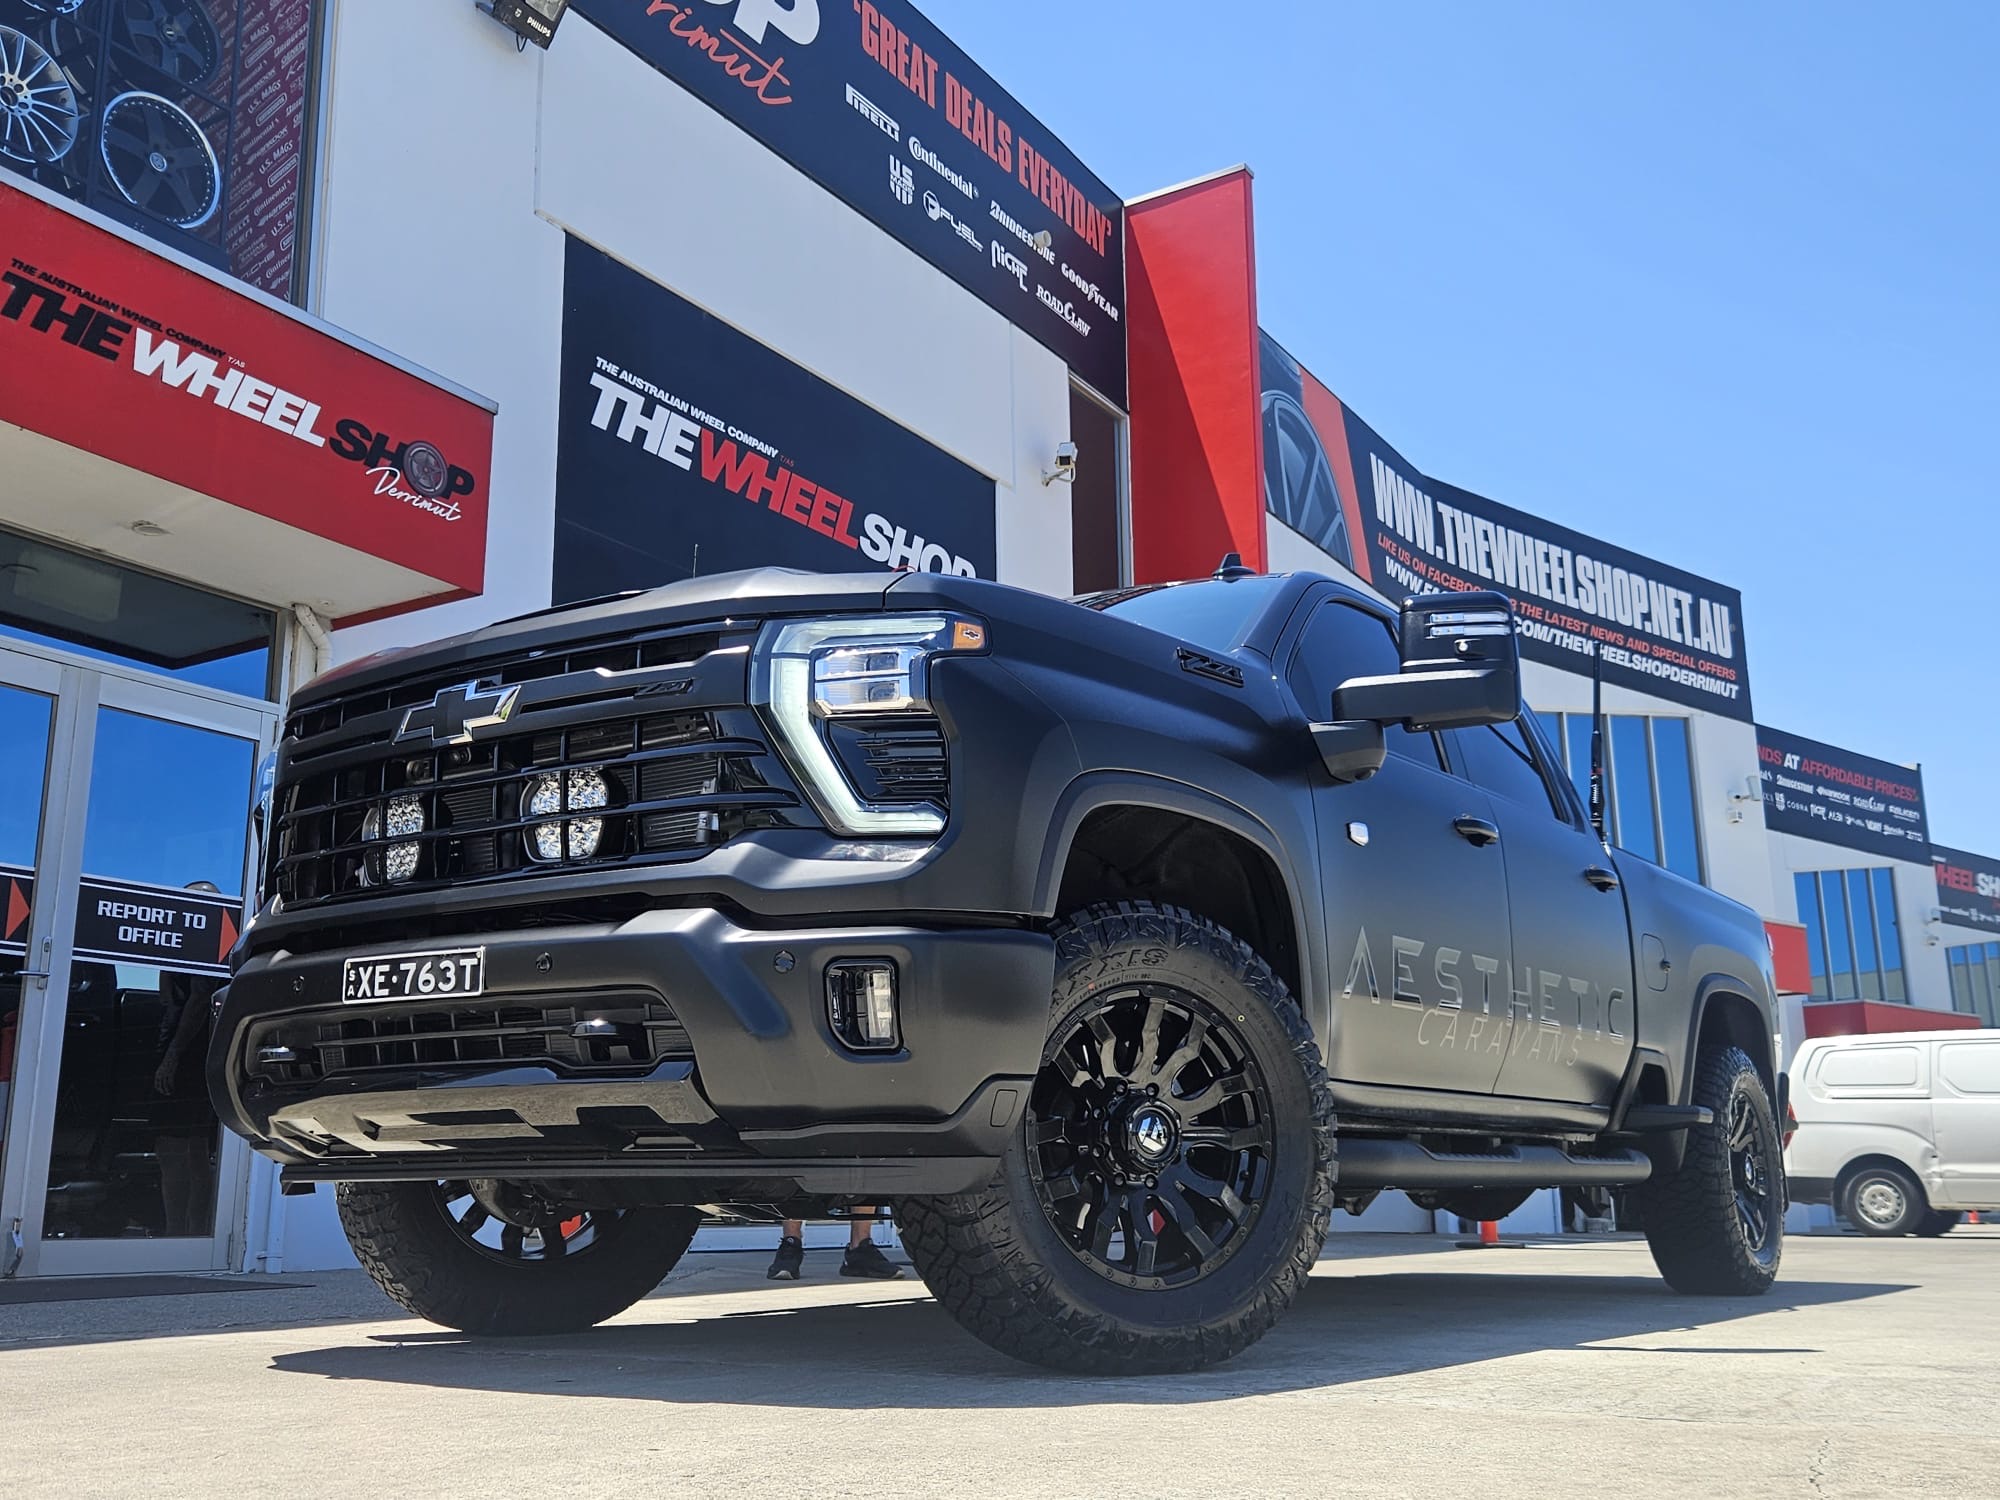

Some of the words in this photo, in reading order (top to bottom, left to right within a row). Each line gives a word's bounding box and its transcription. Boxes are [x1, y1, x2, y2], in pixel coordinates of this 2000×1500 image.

[527, 16, 551, 37] PHILIPS
[262, 79, 281, 100] MAGS
[845, 82, 900, 142] PIRELLI
[945, 71, 1012, 174] DEALS
[259, 158, 274, 175] U.S.
[272, 140, 294, 161] MAGS
[908, 135, 974, 200] Continental
[254, 182, 288, 217] Continental
[271, 219, 286, 237] U.S.
[940, 207, 984, 250] FUEL
[989, 199, 1056, 265] BRIDGESONE
[11, 257, 38, 276] THE
[39, 270, 120, 312] AUSTRALIAN
[118, 306, 163, 333] WHEEL
[165, 327, 227, 360] COMPANY
[227, 355, 246, 369] T/AS
[1, 271, 132, 361] THE
[133, 327, 325, 447] WHEEL
[329, 419, 475, 500] SHOP
[595, 356, 620, 378] THE
[619, 370, 690, 413] AUSTRALIAN
[690, 404, 726, 434] WHEEL
[727, 426, 779, 458] COMPANY
[589, 372, 701, 472] THE
[699, 427, 859, 550] WHEEL
[366, 466, 462, 522] Derrimut
[1369, 452, 1733, 660] WWW.THEWHEELSHOP.NET.AU
[1378, 533, 1396, 556] LIKE
[1398, 549, 1412, 566] US
[1412, 556, 1427, 576] ON
[1428, 564, 1487, 592] FACEBO
[1519, 602, 1543, 619] THE
[1545, 609, 1588, 635] LATEST
[1590, 624, 1625, 647] NEWS
[1626, 636, 1651, 654] AND
[1652, 644, 1696, 669] SPECIAL
[1698, 659, 1737, 681] OFFERS
[1783, 752, 1800, 770] AT
[1801, 758, 1874, 791] AFFORDABLE
[97, 900, 177, 925] REPORT
[182, 911, 207, 930] TO
[118, 926, 184, 949] OFFICE
[1342, 926, 1625, 1044] AESTHETIC
[1417, 1009, 1584, 1066] CARAVANS
